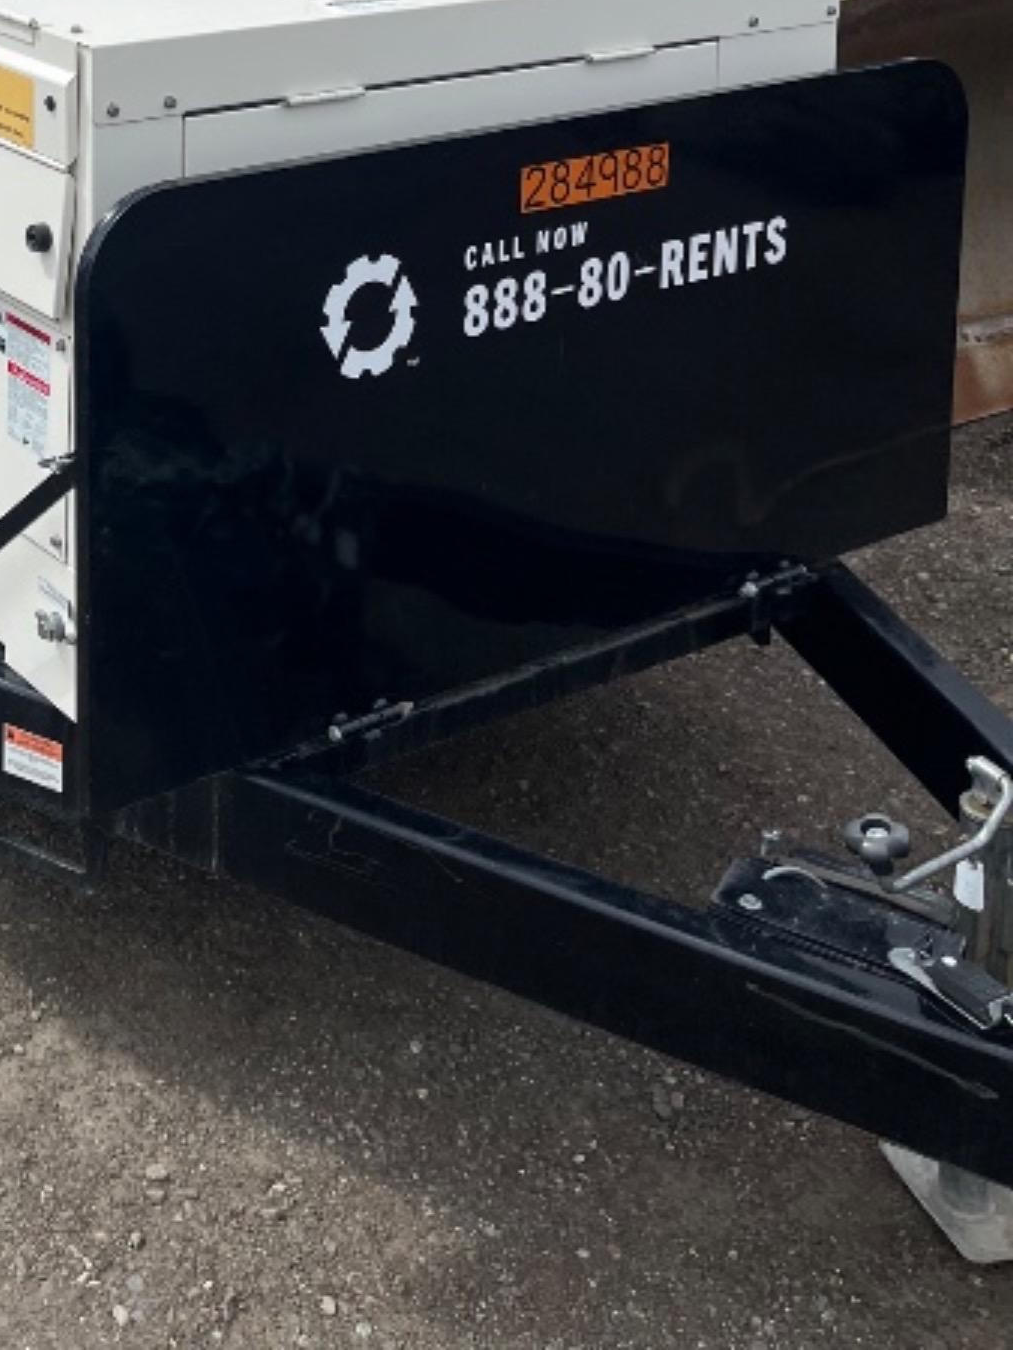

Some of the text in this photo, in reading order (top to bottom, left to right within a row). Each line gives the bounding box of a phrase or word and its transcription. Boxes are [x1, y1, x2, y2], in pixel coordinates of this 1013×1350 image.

[524, 146, 666, 207] 284988
[463, 216, 787, 337] 888-80-RENTS
[465, 221, 588, 271] CALL NOW
